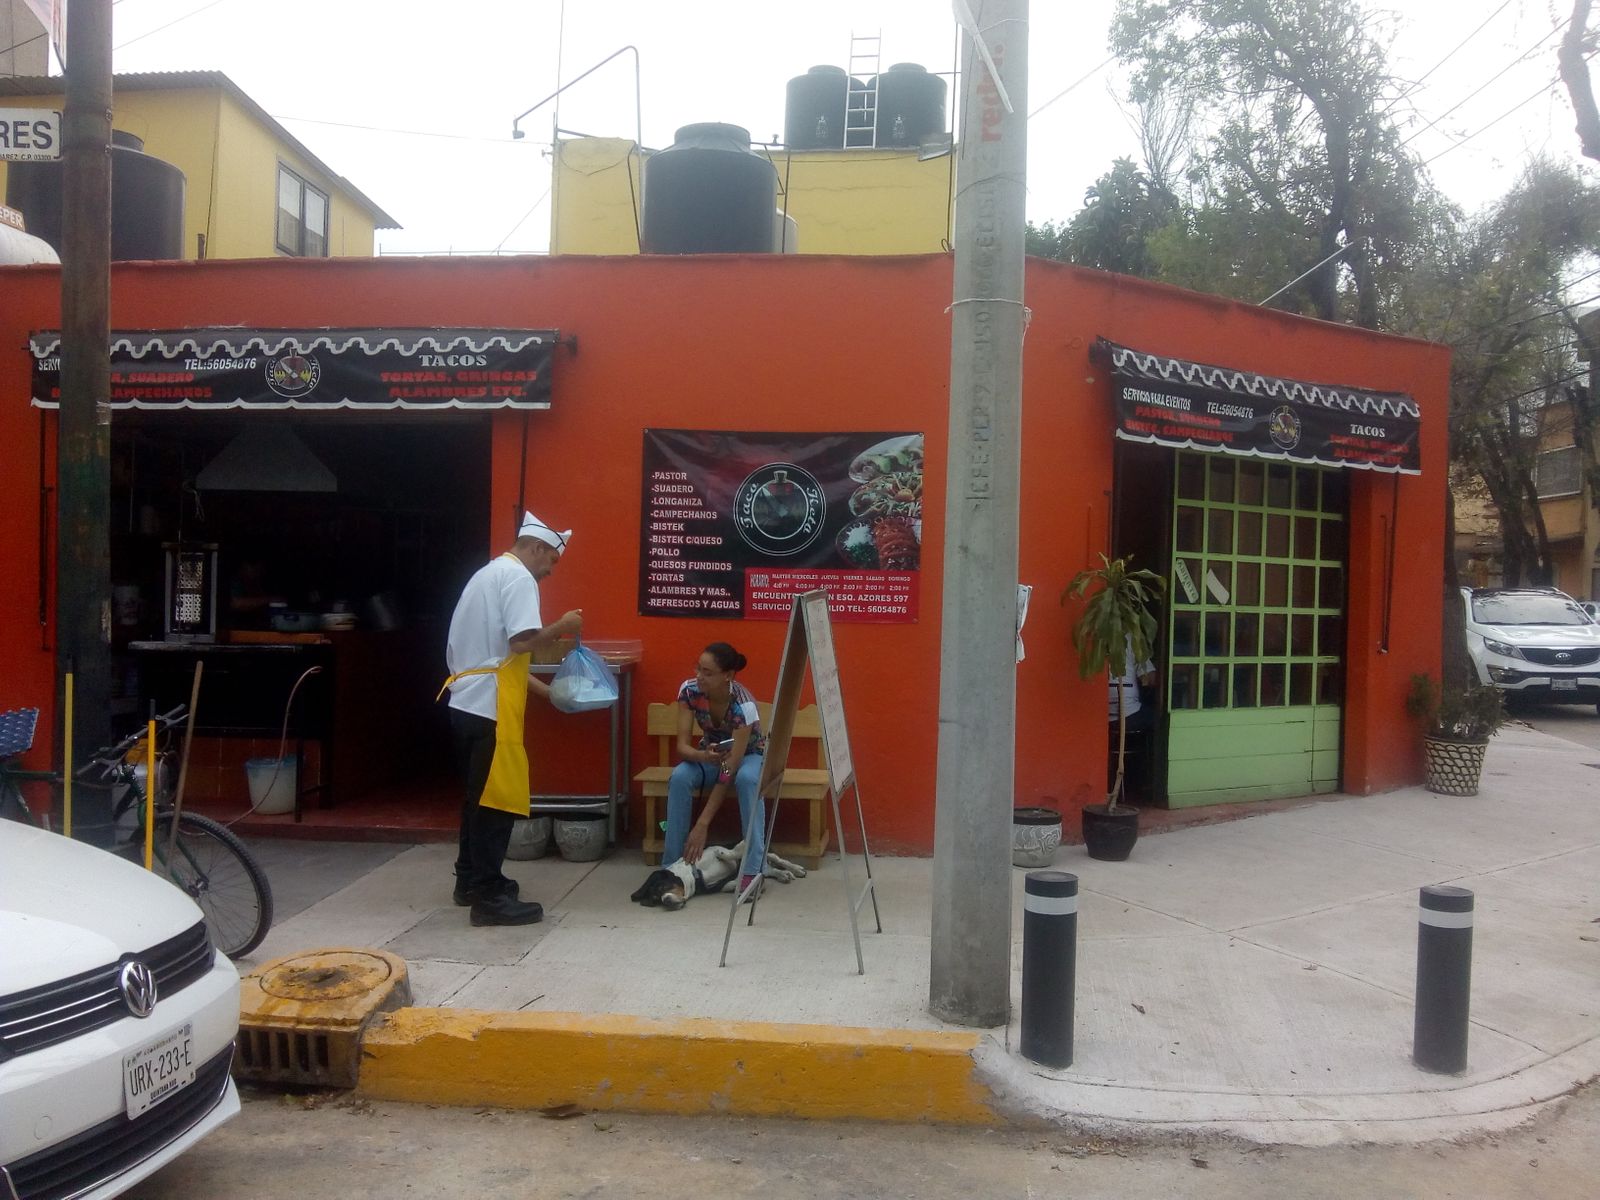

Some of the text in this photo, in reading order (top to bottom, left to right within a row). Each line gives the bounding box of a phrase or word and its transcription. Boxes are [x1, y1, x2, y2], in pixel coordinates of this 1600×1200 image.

[38, 358, 60, 371] SERVI
[418, 354, 487, 367] TACOS
[111, 386, 213, 398] AMPECHANOS
[1165, 394, 1192, 411] EVENTOS
[1350, 423, 1386, 438] TACOS
[688, 562, 732, 570] FUNDIDOS
[699, 587, 705, 595] Y
[858, 594, 891, 602] AZORES
[703, 600, 708, 608] Y
[711, 600, 740, 609] AGUAS
[752, 602, 791, 611] SERVICIO
[847, 605, 865, 613] TEL:
[867, 606, 907, 614] 56054876
[129, 1039, 192, 1097] URX-233-E
